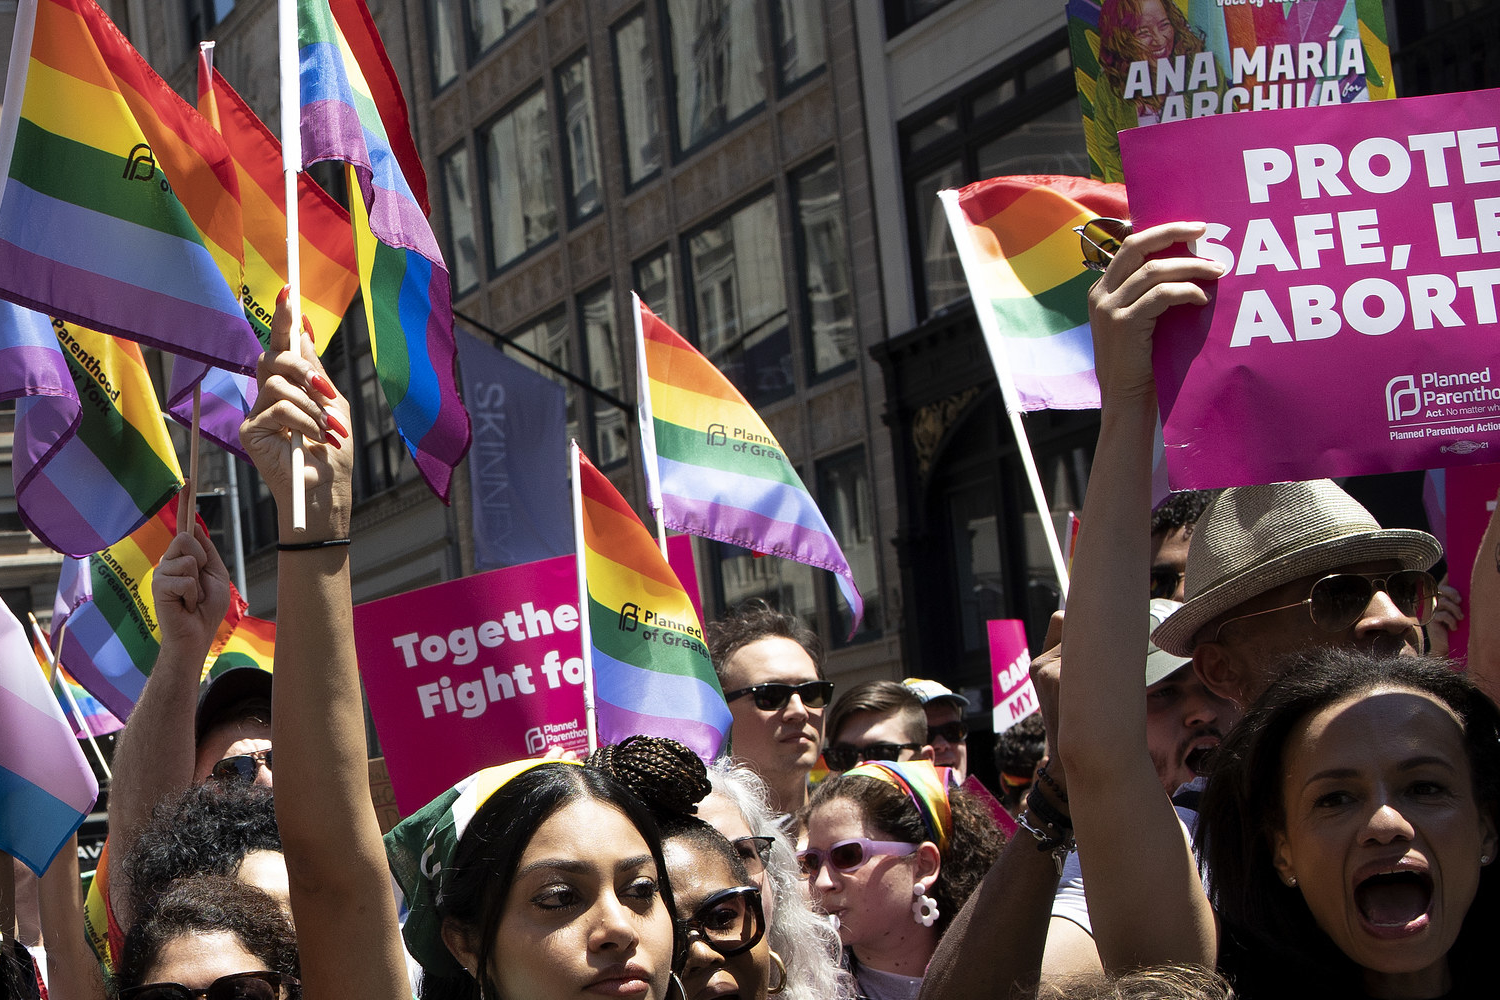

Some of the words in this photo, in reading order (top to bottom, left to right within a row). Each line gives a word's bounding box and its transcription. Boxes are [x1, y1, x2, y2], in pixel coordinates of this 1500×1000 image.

[1124, 52, 1217, 99] ANA
[1232, 25, 1366, 84] MARÍA
[1341, 82, 1362, 97] for
[1243, 127, 1500, 203] PROTE
[1187, 209, 1411, 279] SAFE,
[1230, 269, 1500, 347] ABORT
[52, 318, 121, 404] Parenthood
[1421, 367, 1491, 389] Planned
[83, 378, 112, 416] York
[1423, 386, 1500, 407] Parentho
[1426, 410, 1445, 418] Act.
[1446, 408, 1458, 416] No
[1459, 406, 1486, 415] matter
[733, 443, 747, 453] of
[1389, 429, 1424, 441] Planned
[1426, 424, 1475, 437] Parenthood
[98, 564, 128, 604] Greater
[125, 602, 141, 625] New
[136, 619, 150, 642] York
[101, 548, 135, 587] lanned
[130, 584, 158, 632] Parenthood
[392, 602, 580, 668] Togethe
[643, 629, 660, 642] of
[645, 610, 703, 640] Planned
[417, 664, 536, 718] Fight
[1009, 688, 1033, 720] MY
[544, 718, 578, 734] Planned
